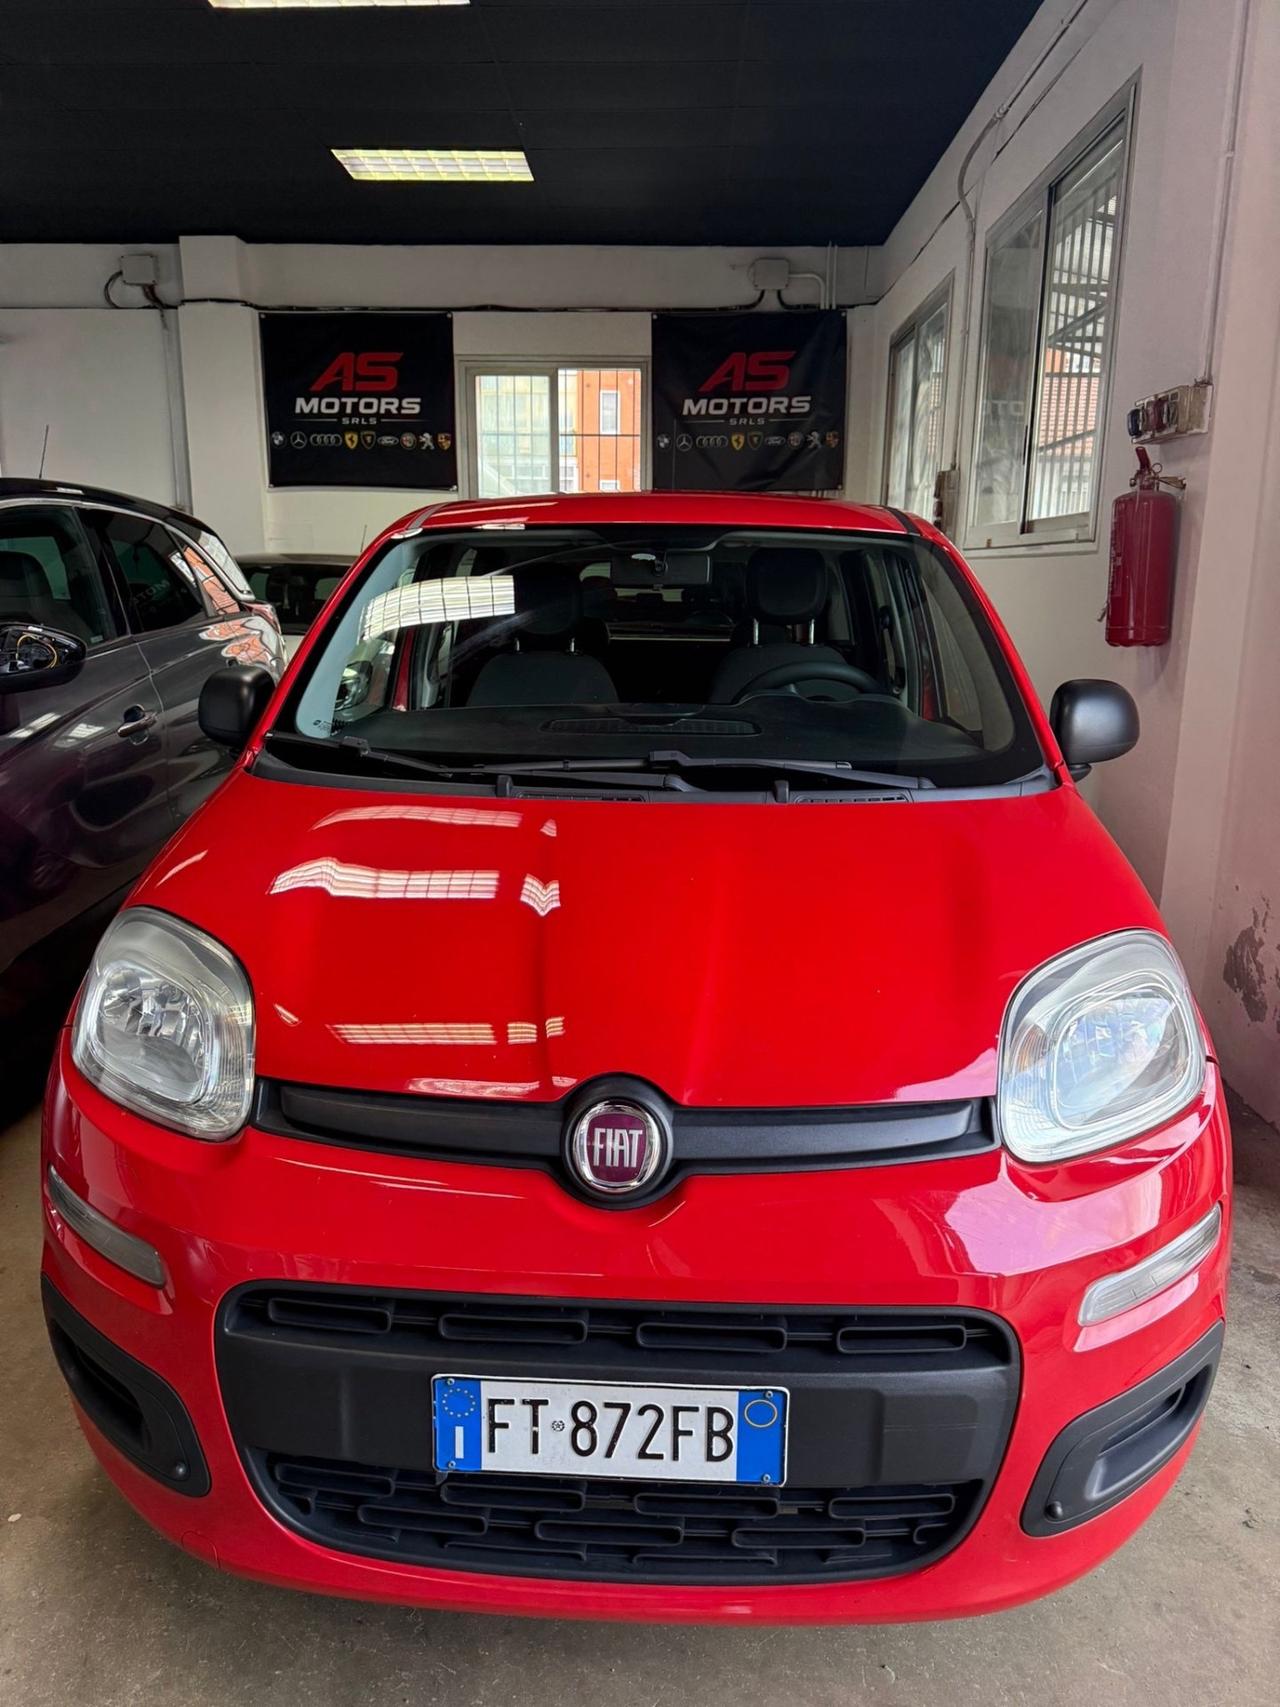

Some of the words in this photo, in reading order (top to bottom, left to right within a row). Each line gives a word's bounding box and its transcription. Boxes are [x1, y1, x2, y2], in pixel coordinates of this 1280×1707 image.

[309, 352, 404, 392] AS
[698, 351, 797, 392] AS
[295, 397, 421, 415] MOTORS
[682, 396, 812, 416] MOTORS
[341, 417, 378, 425] SRLS
[729, 417, 766, 426] SRLS
[593, 1127, 643, 1168] FIAT
